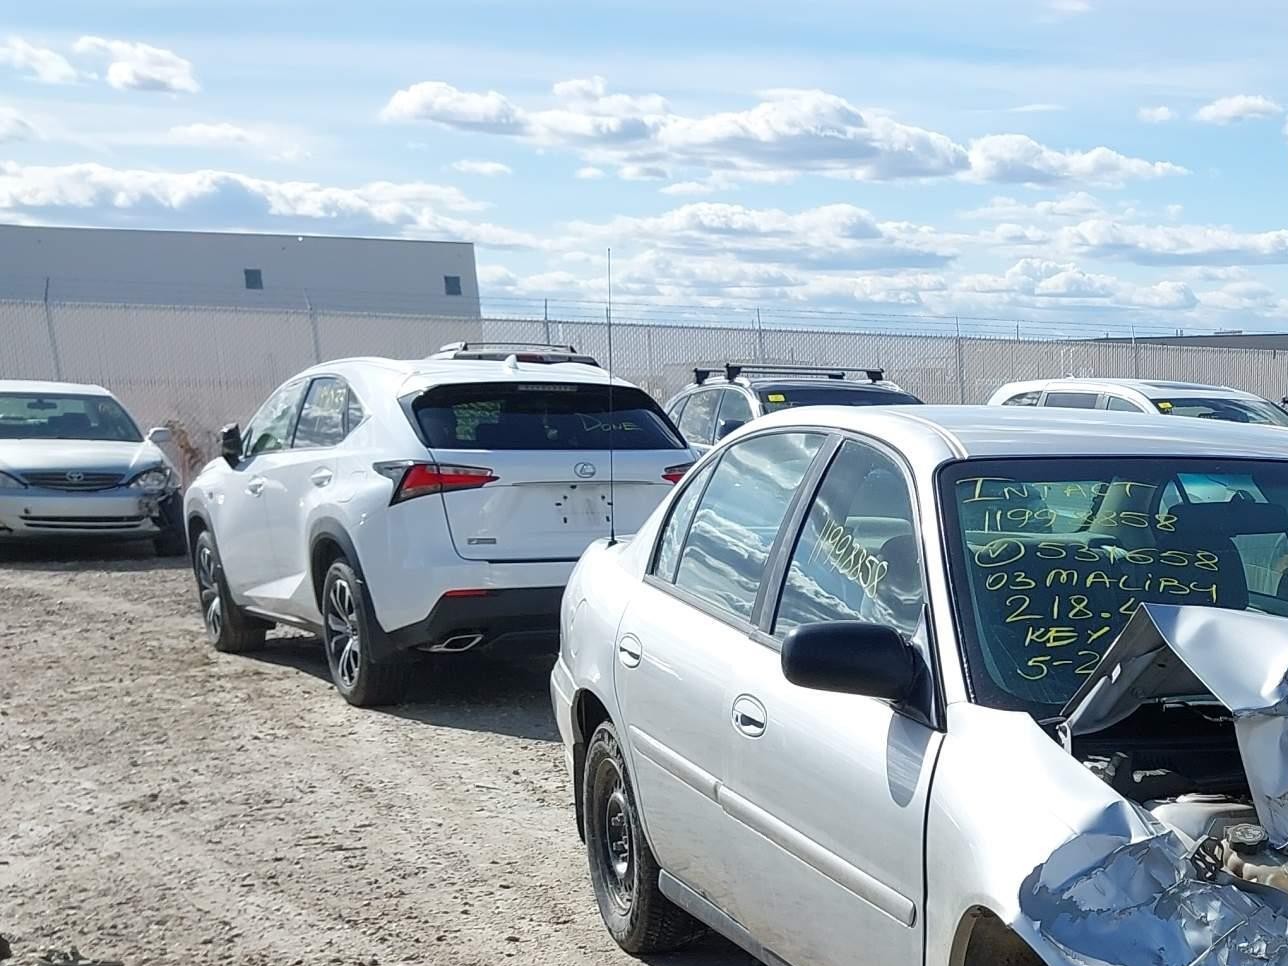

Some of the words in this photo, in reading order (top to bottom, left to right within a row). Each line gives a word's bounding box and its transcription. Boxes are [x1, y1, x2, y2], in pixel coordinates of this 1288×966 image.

[984, 509, 1179, 533] 11998858
[807, 519, 889, 598] 11998858
[985, 571, 1037, 591] 03
